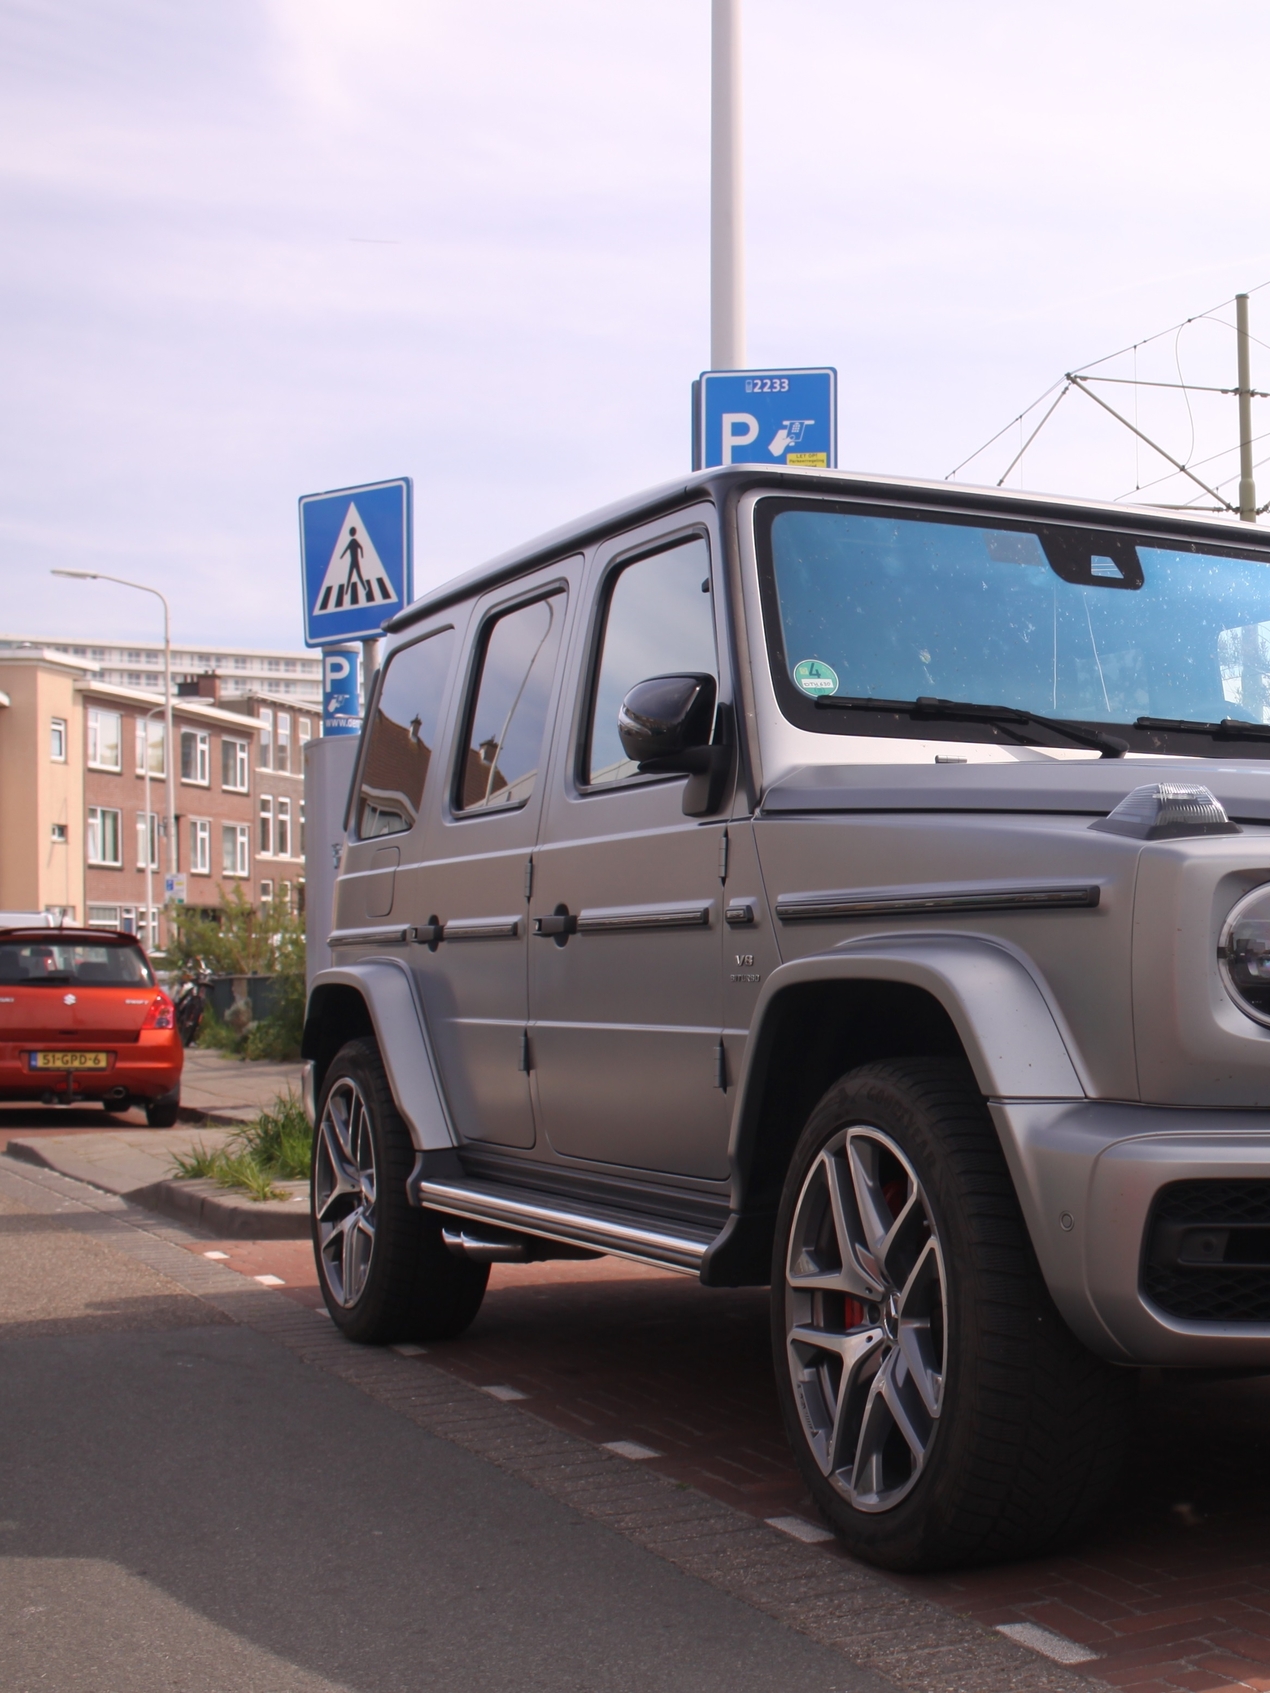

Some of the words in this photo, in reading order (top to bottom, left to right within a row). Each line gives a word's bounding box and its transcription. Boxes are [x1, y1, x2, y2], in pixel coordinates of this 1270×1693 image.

[753, 379, 789, 392] 2233
[722, 412, 759, 465] P
[325, 656, 350, 693] P
[809, 663, 821, 678] 4
[735, 954, 754, 966] V8
[42, 1053, 101, 1066] 51-GPD-6
